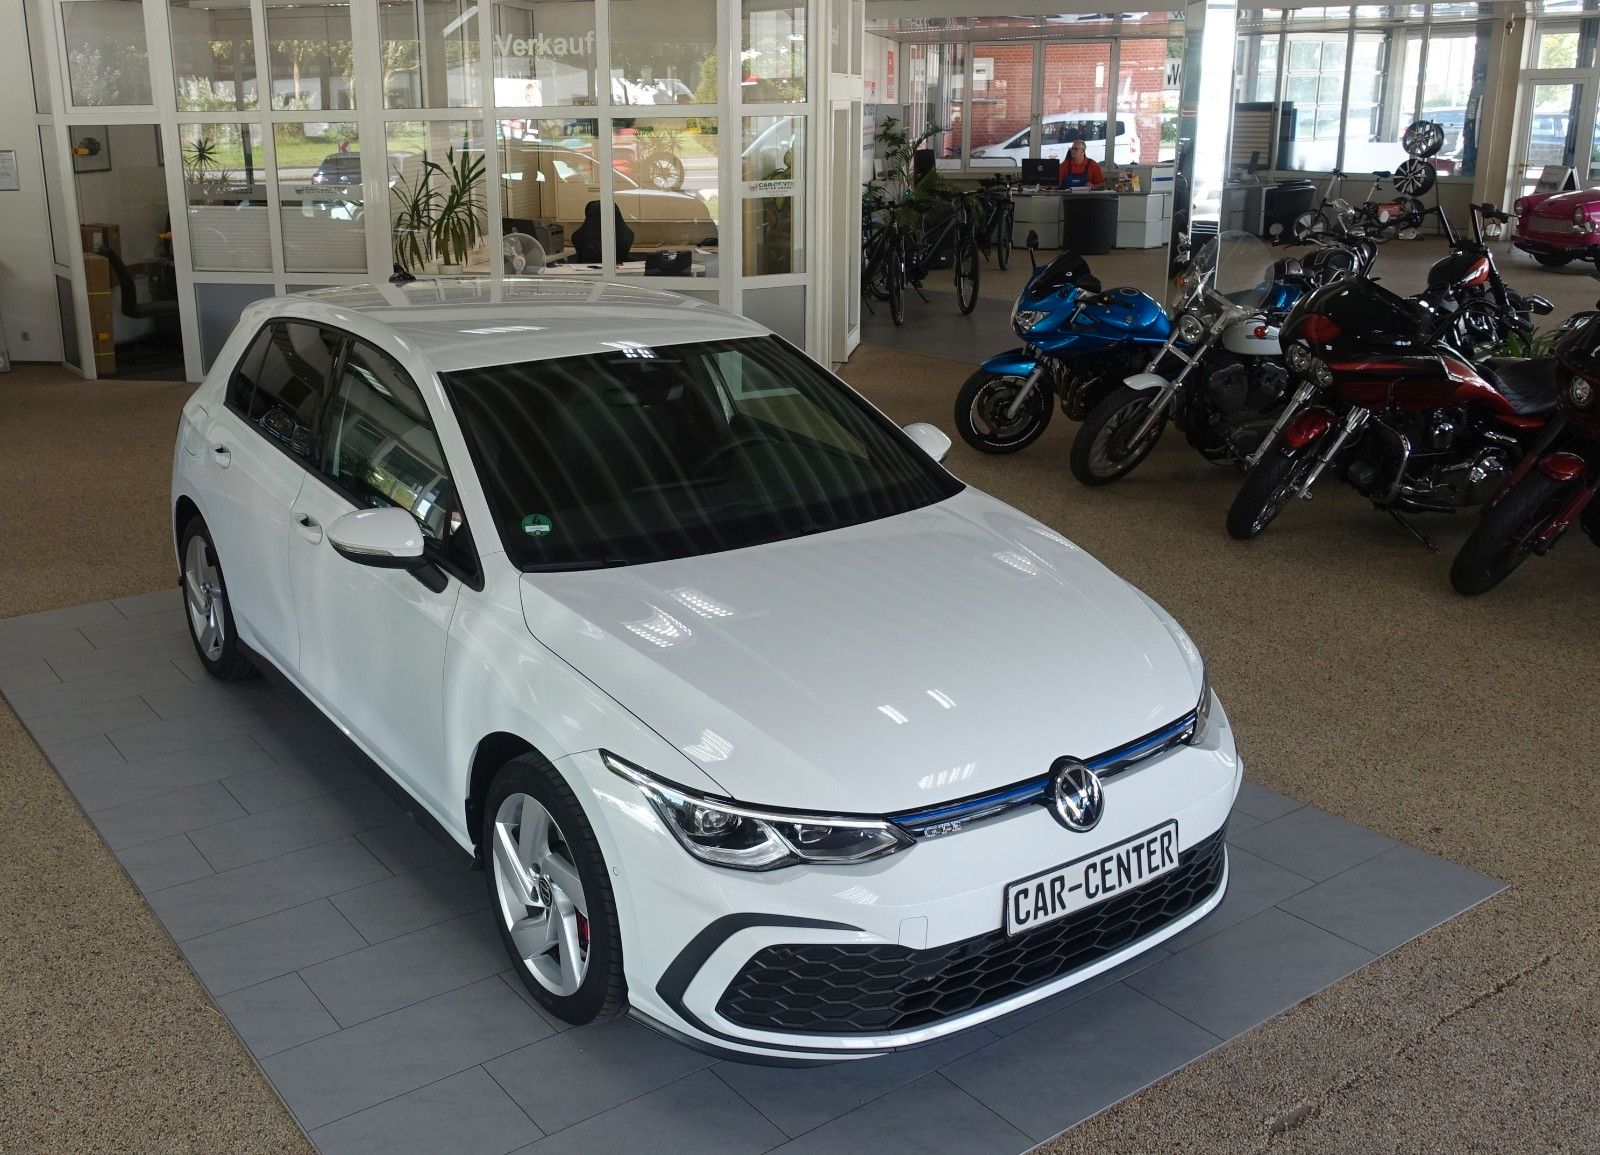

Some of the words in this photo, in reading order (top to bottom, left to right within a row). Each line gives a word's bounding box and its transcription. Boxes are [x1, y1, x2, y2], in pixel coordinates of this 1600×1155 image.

[494, 31, 595, 56] Verkauf
[924, 821, 961, 837] GTE
[1014, 830, 1174, 925] CAR-CENTER
